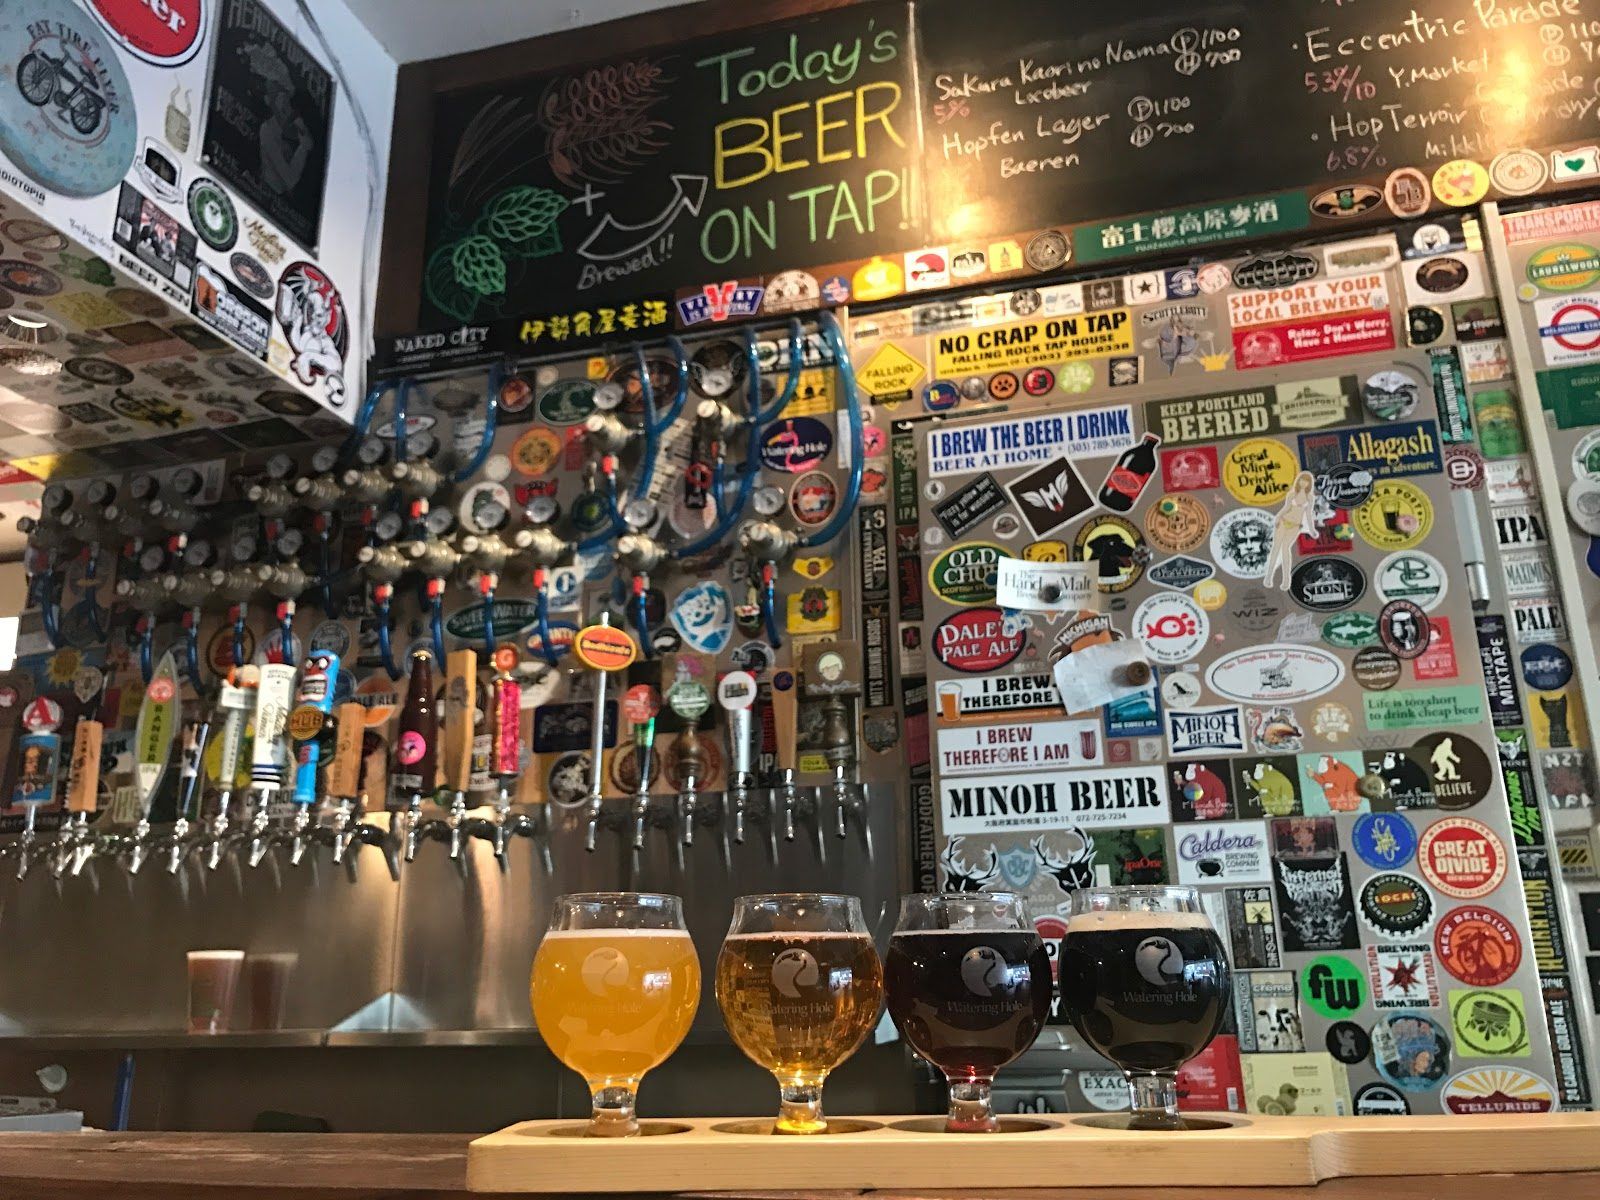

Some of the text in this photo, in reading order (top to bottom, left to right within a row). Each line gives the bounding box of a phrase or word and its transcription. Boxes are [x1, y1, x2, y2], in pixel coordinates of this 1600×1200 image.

[27, 19, 51, 40] FAT
[55, 21, 92, 51] TIRE
[1305, 0, 1582, 62] Eccentric Parade
[695, 18, 898, 104] Today's
[1105, 40, 1171, 66] Nama
[714, 81, 906, 189] BEER
[943, 122, 1025, 161] Hopfen
[1036, 113, 1110, 145] Lager
[1330, 111, 1384, 142] Hop
[0, 168, 46, 202] DIOTOPIA
[701, 199, 776, 263] ON
[577, 234, 674, 290] Brewed!!
[1231, 275, 1382, 309] SUPPORT YOUR
[1233, 293, 1372, 323] LOCAL BREWERY
[394, 325, 491, 352] NAKED CITY
[939, 310, 1128, 355] NO CRAP ON TAP
[1292, 336, 1321, 350] Have
[1333, 329, 1388, 344] Homebrew
[952, 350, 1003, 364] FALLING
[1004, 344, 1040, 358] ROCK
[1043, 338, 1068, 351] TAP
[1071, 333, 1115, 347] HOUSE
[865, 362, 914, 379] FALLING
[874, 377, 908, 390] ROCK
[1160, 392, 1266, 417] KEEP PORTLAND
[932, 409, 1131, 458] I BREW THE BEER I DRINK
[1163, 408, 1270, 441] BEERED
[1232, 448, 1270, 465] Great
[1347, 425, 1434, 464] Allagash
[933, 457, 975, 473] BEER
[980, 454, 998, 468] AT
[1003, 449, 1052, 465] HOME
[1241, 462, 1281, 475] Minds
[1238, 474, 1275, 489] Drink
[1253, 482, 1290, 496] Alike
[1497, 516, 1544, 544] IPA
[948, 548, 997, 568] OLD
[1004, 572, 1092, 591] Hand Malt
[1303, 583, 1354, 602] STONE
[1059, 617, 1108, 642] MICHIGAN
[1515, 606, 1561, 632] PALE
[939, 620, 1003, 646] DALE'
[941, 639, 1020, 663] PALE ALE
[1491, 637, 1515, 706] MIXTAPE
[983, 680, 988, 693] I
[963, 691, 1053, 709] THEREFORE
[1368, 697, 1392, 709] Life
[1369, 704, 1480, 720] to drink cheap beer
[150, 702, 166, 764] RANGER
[977, 727, 1032, 745] I BREW
[1172, 714, 1240, 744] MINOH
[1188, 732, 1225, 746] BEER
[944, 744, 1069, 767] THEREFORE I AM
[949, 783, 1057, 818] MINOH
[1069, 776, 1161, 812] BEER
[919, 784, 936, 868] GODFATHER
[1179, 828, 1258, 861] Caldera
[1225, 850, 1259, 861] BREWING
[1433, 840, 1487, 858] GREAT
[1226, 859, 1260, 869] COMPANY
[1435, 856, 1492, 875] DIVIDE
[920, 872, 936, 895] OF
[1375, 891, 1417, 904] LOCAL
[1440, 925, 1453, 956] NEW
[1454, 911, 1513, 943] BELGIUM
[1376, 943, 1431, 953] BREWING
[1122, 991, 1198, 1005] Watering Hole
[1457, 1101, 1542, 1113] TELLURIDE
